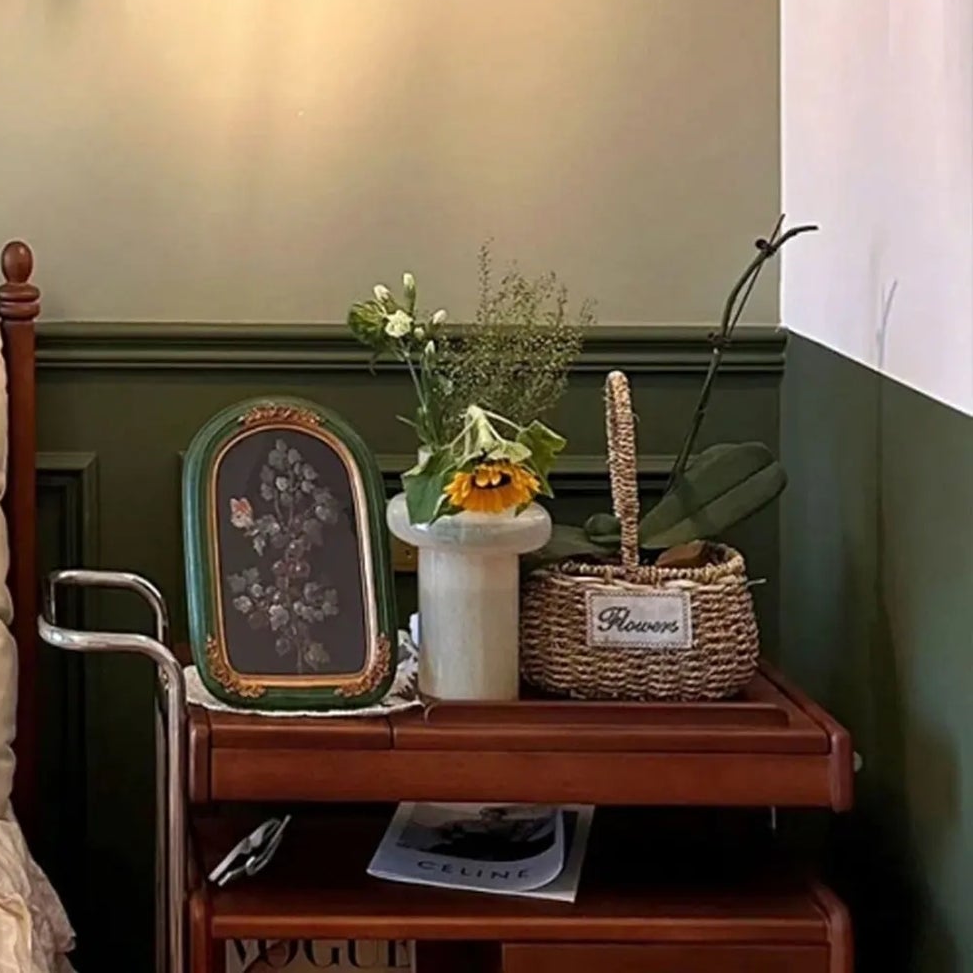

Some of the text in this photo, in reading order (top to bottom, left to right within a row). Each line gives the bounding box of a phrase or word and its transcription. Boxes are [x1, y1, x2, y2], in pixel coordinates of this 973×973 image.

[597, 606, 679, 633] Flowers
[417, 860, 530, 879] CELINE
[233, 939, 412, 969] VOGUE
